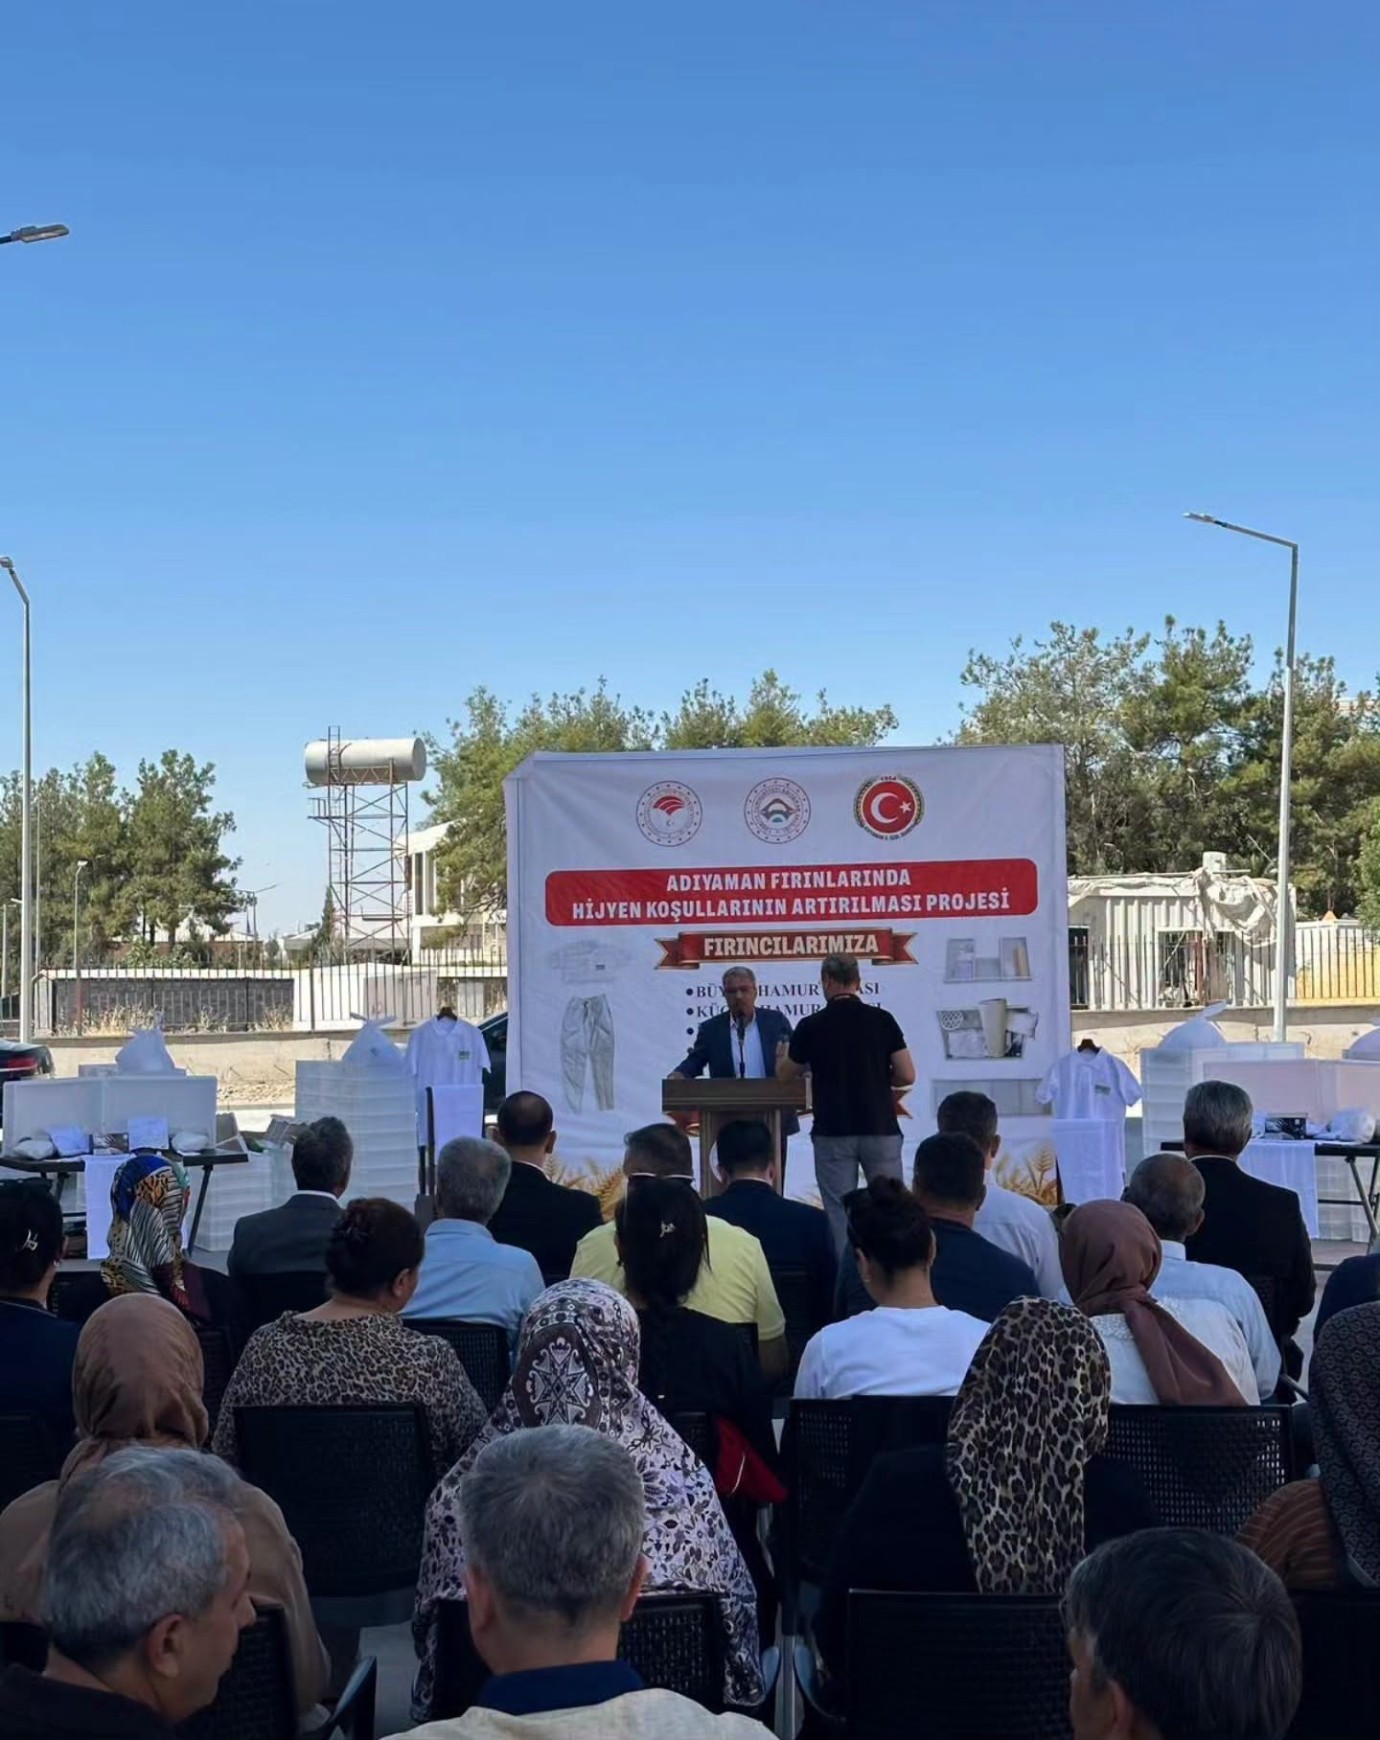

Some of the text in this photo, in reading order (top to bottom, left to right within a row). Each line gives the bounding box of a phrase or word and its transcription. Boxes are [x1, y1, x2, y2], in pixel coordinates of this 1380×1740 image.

[666, 869, 911, 892] ADIYAMAN FIRINLARINDA
[572, 887, 1010, 922] HİJYEN KOŞULLARININ ARTIRILMASI PROJESİ
[704, 934, 879, 957] FIRINCILARIMIZA
[758, 983, 819, 997] HAMUR
